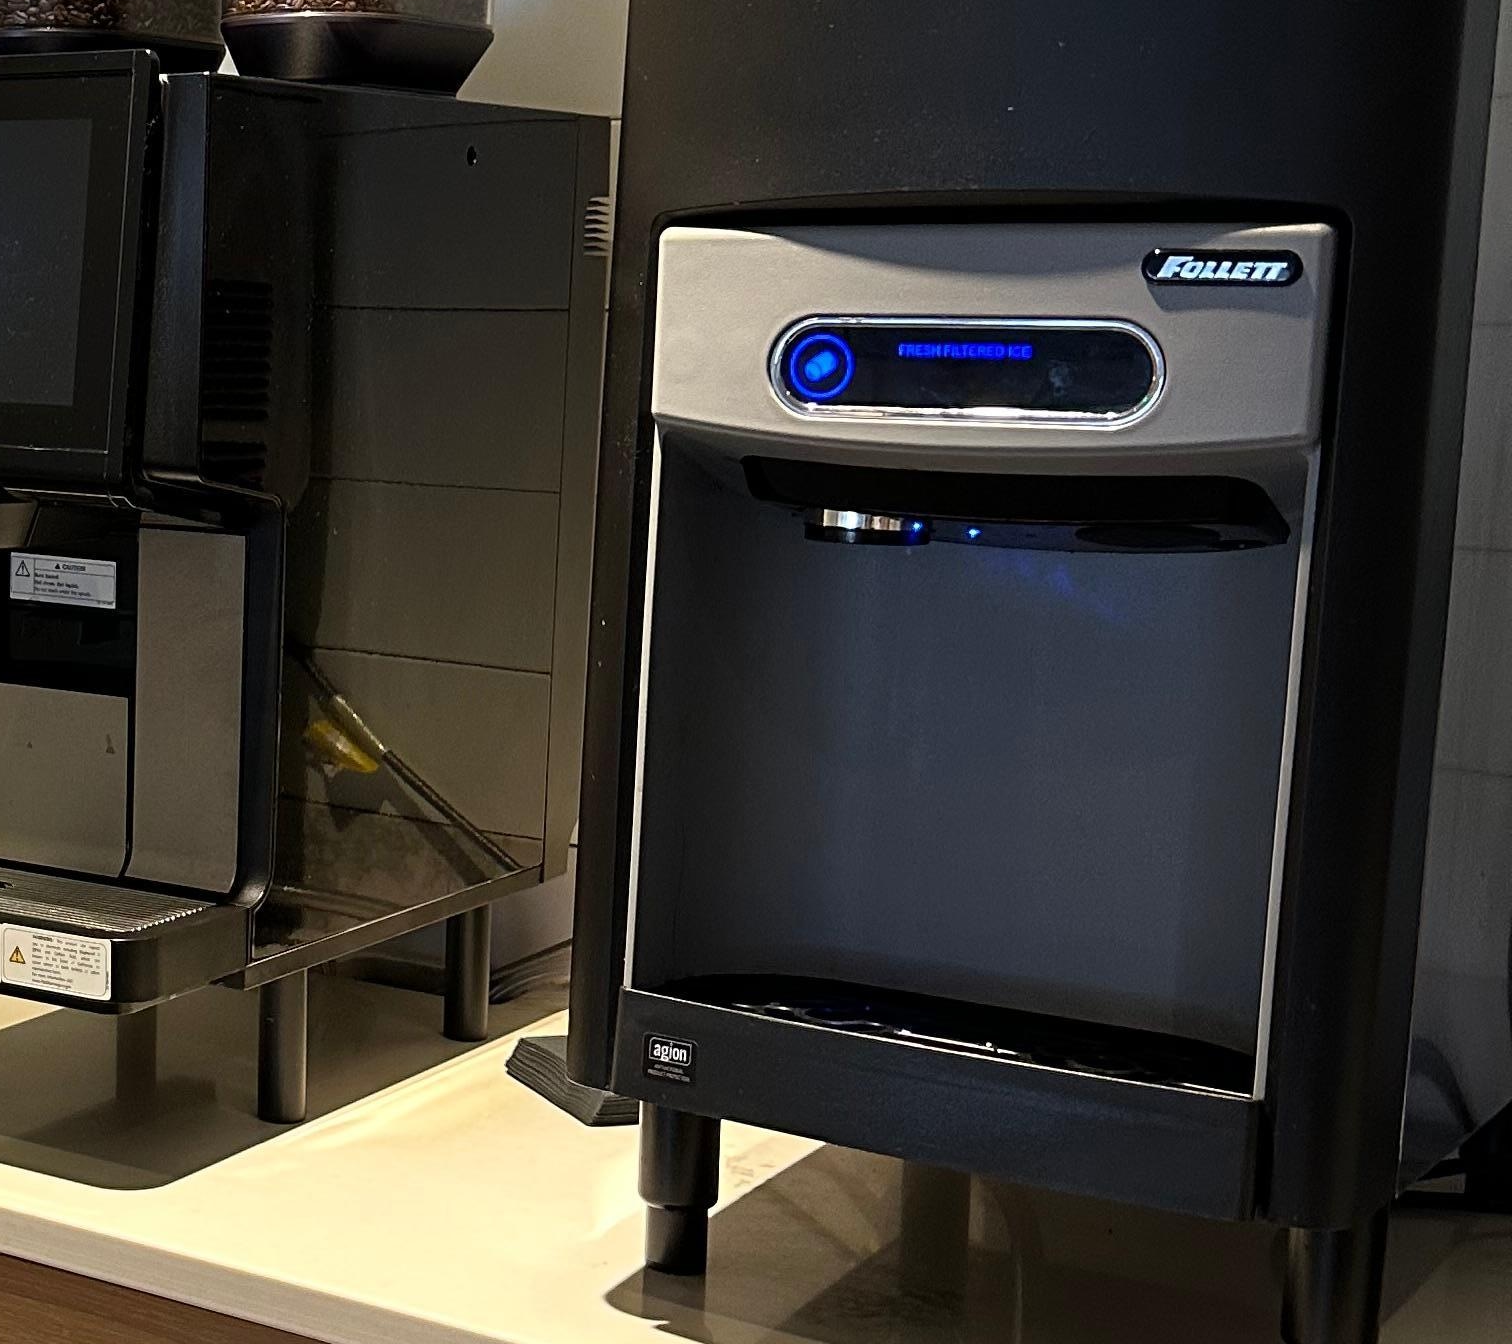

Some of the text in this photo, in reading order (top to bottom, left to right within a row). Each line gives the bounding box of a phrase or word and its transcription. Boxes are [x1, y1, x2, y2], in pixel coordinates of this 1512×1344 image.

[1156, 256, 1288, 280] FOLLETT
[898, 343, 940, 357] FRESH
[943, 344, 1005, 358] FILTERED
[653, 1040, 687, 1062] agion
